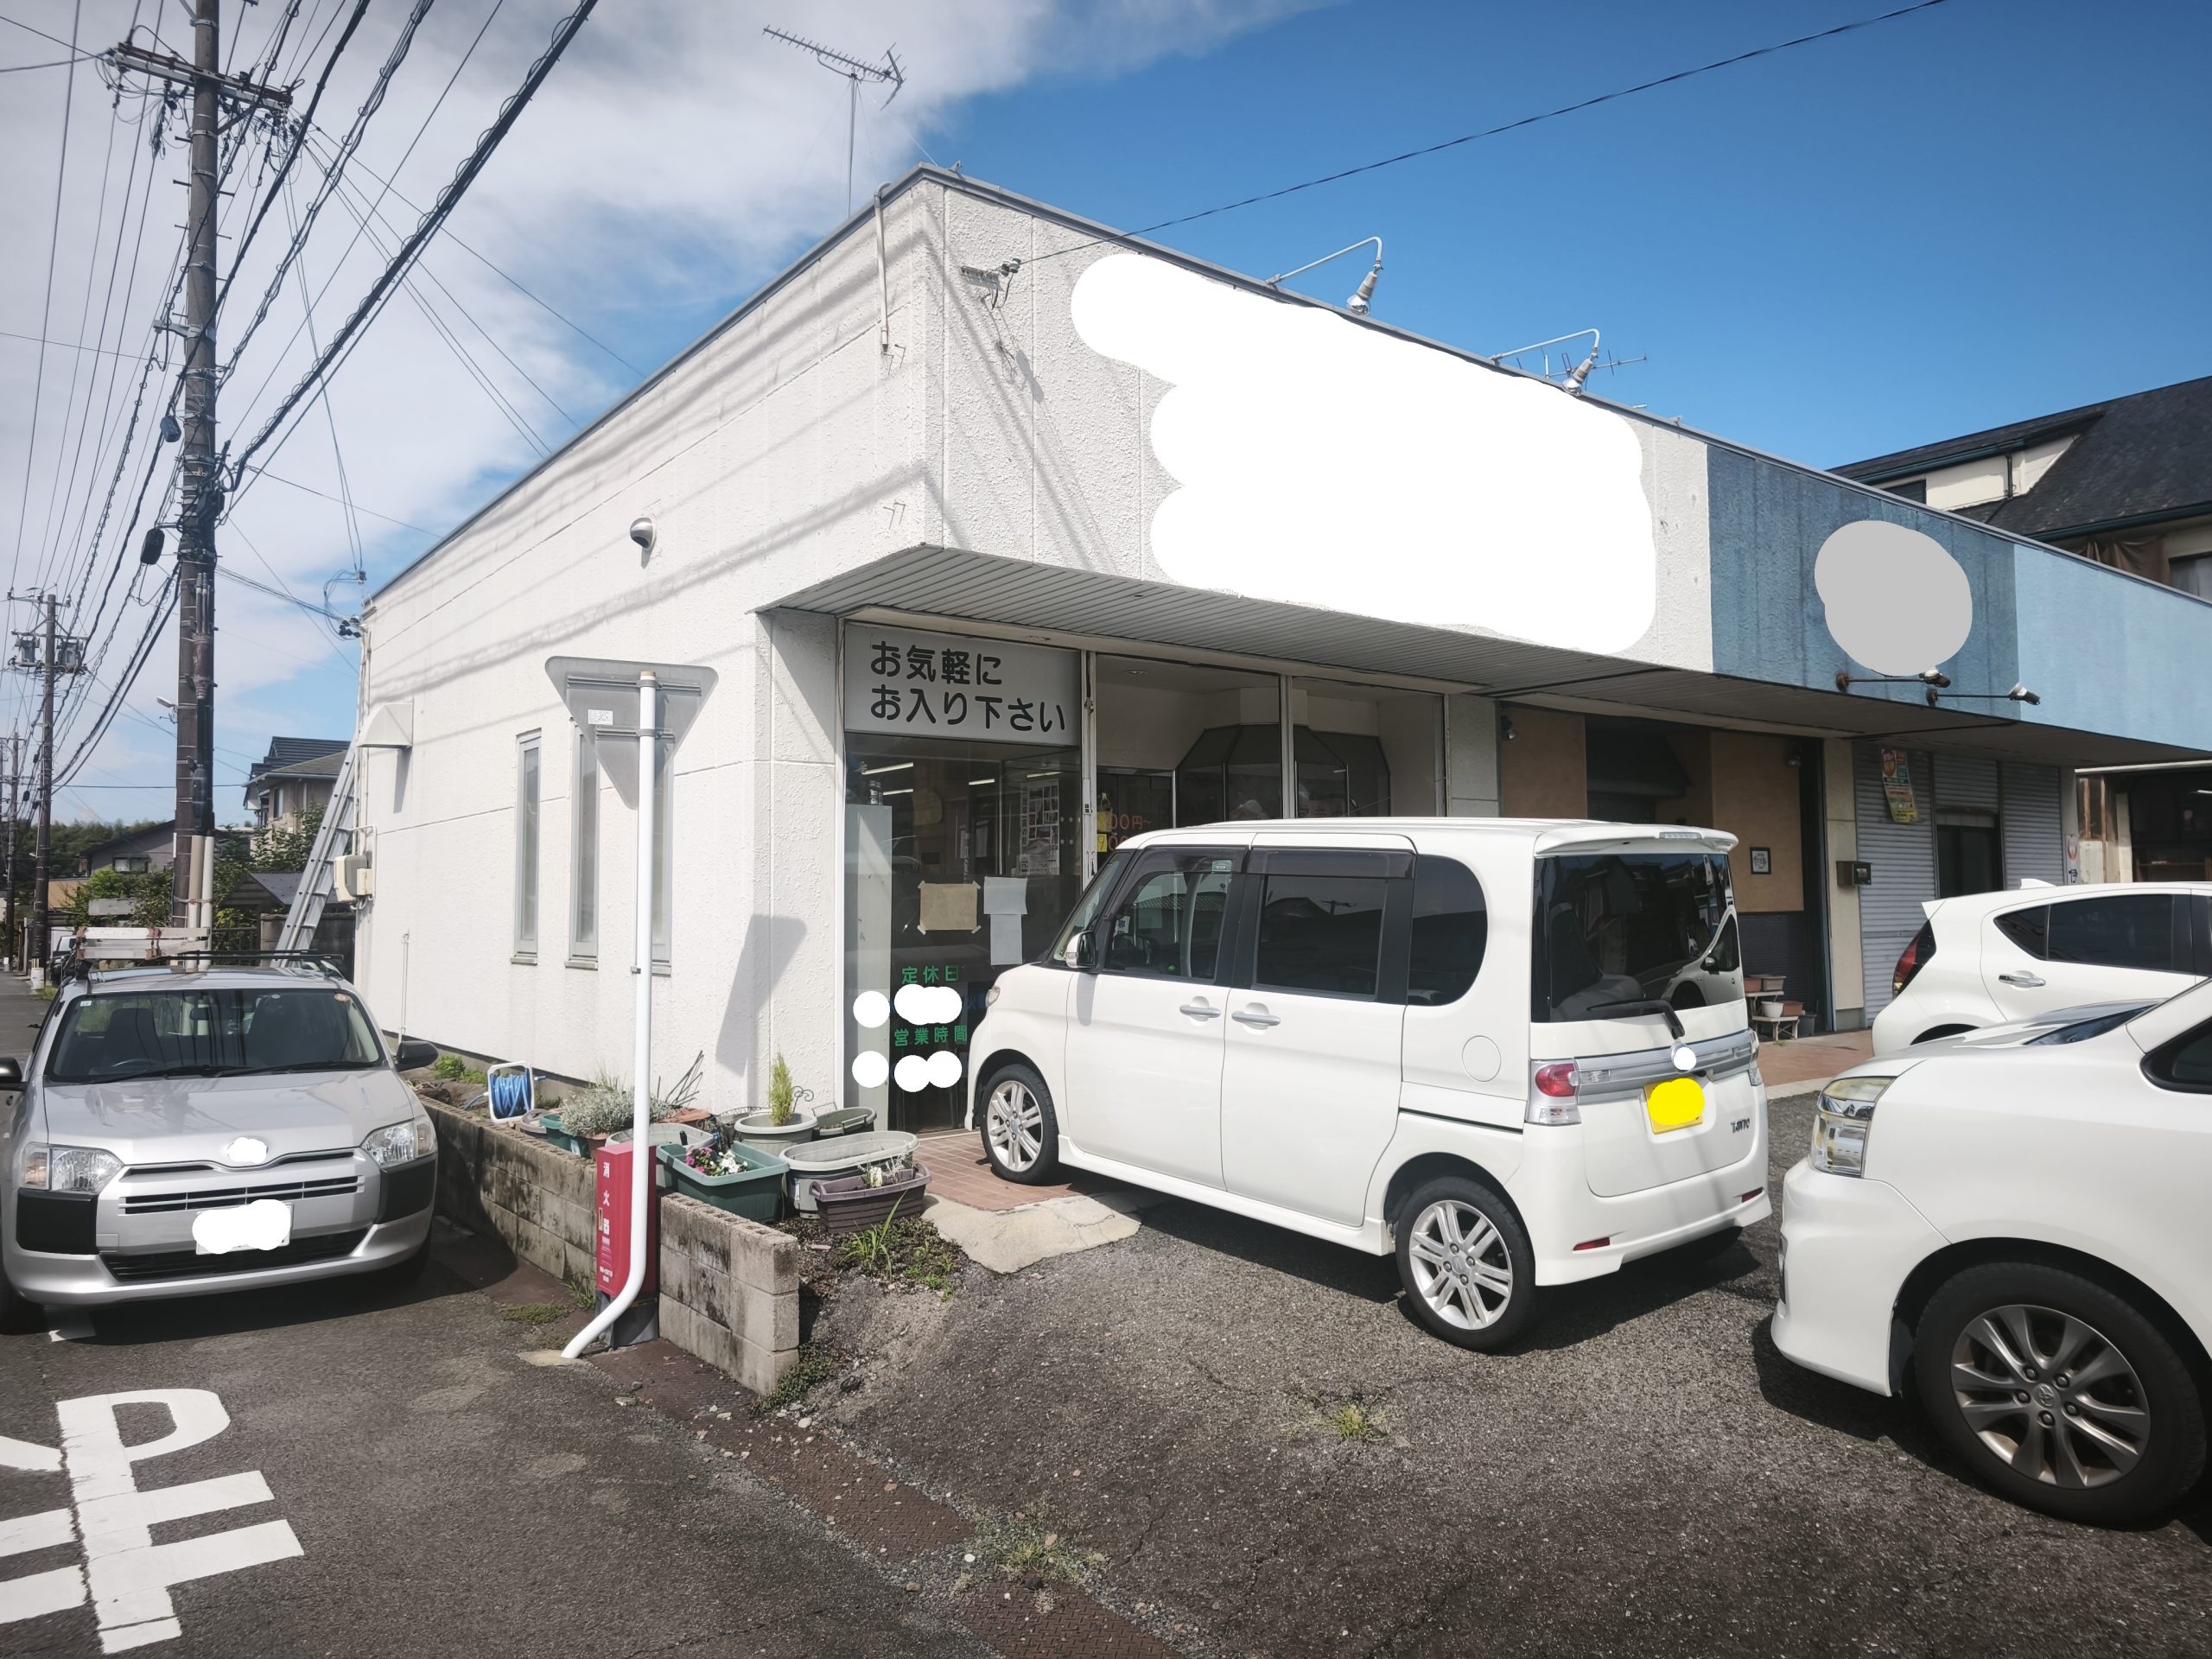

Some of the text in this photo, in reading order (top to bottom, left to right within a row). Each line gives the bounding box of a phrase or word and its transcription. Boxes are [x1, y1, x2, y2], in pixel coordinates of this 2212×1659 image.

[870, 640, 1002, 684] お気軽に
[870, 683, 1065, 733] お入り下さい
[901, 965, 959, 984] 定休日
[893, 1025, 968, 1047] 営業時間
